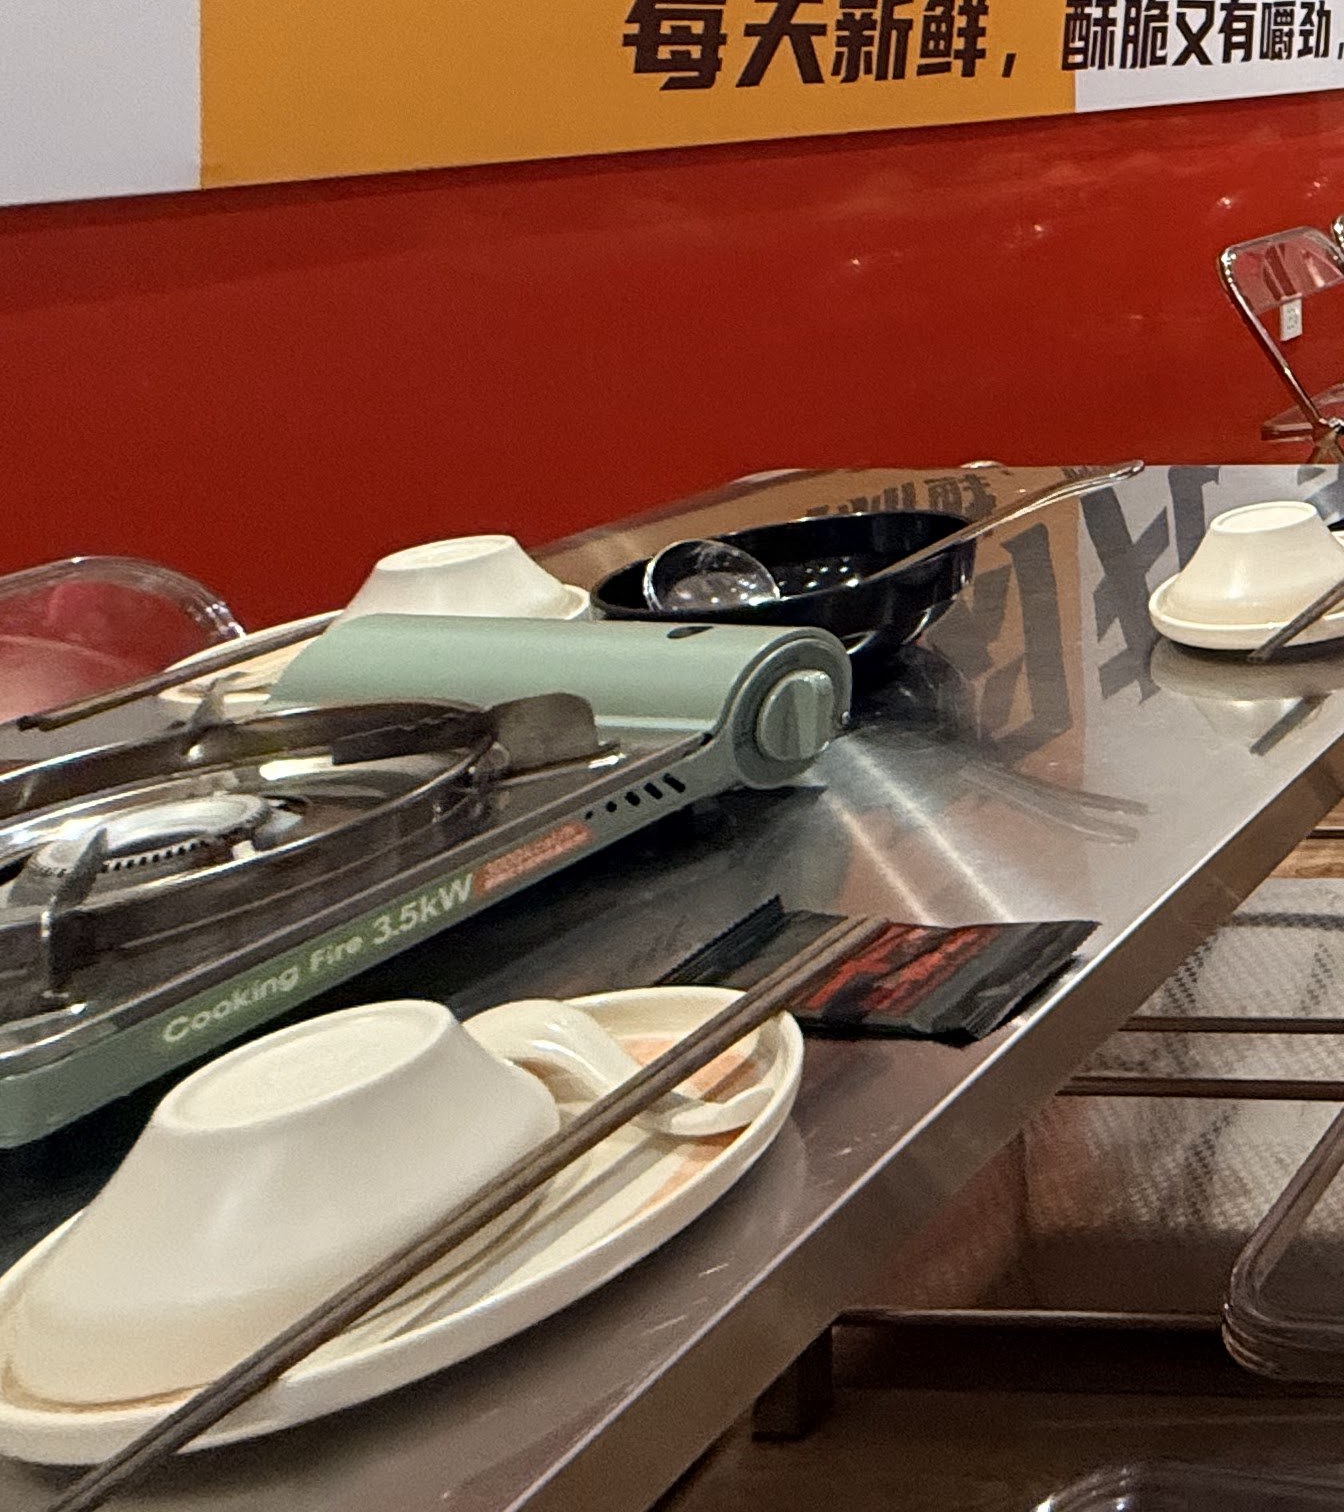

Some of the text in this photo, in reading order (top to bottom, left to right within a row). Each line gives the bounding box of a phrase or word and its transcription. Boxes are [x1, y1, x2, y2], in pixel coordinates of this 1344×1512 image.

[162, 871, 476, 1044] Cooking Fire 3.5kW
